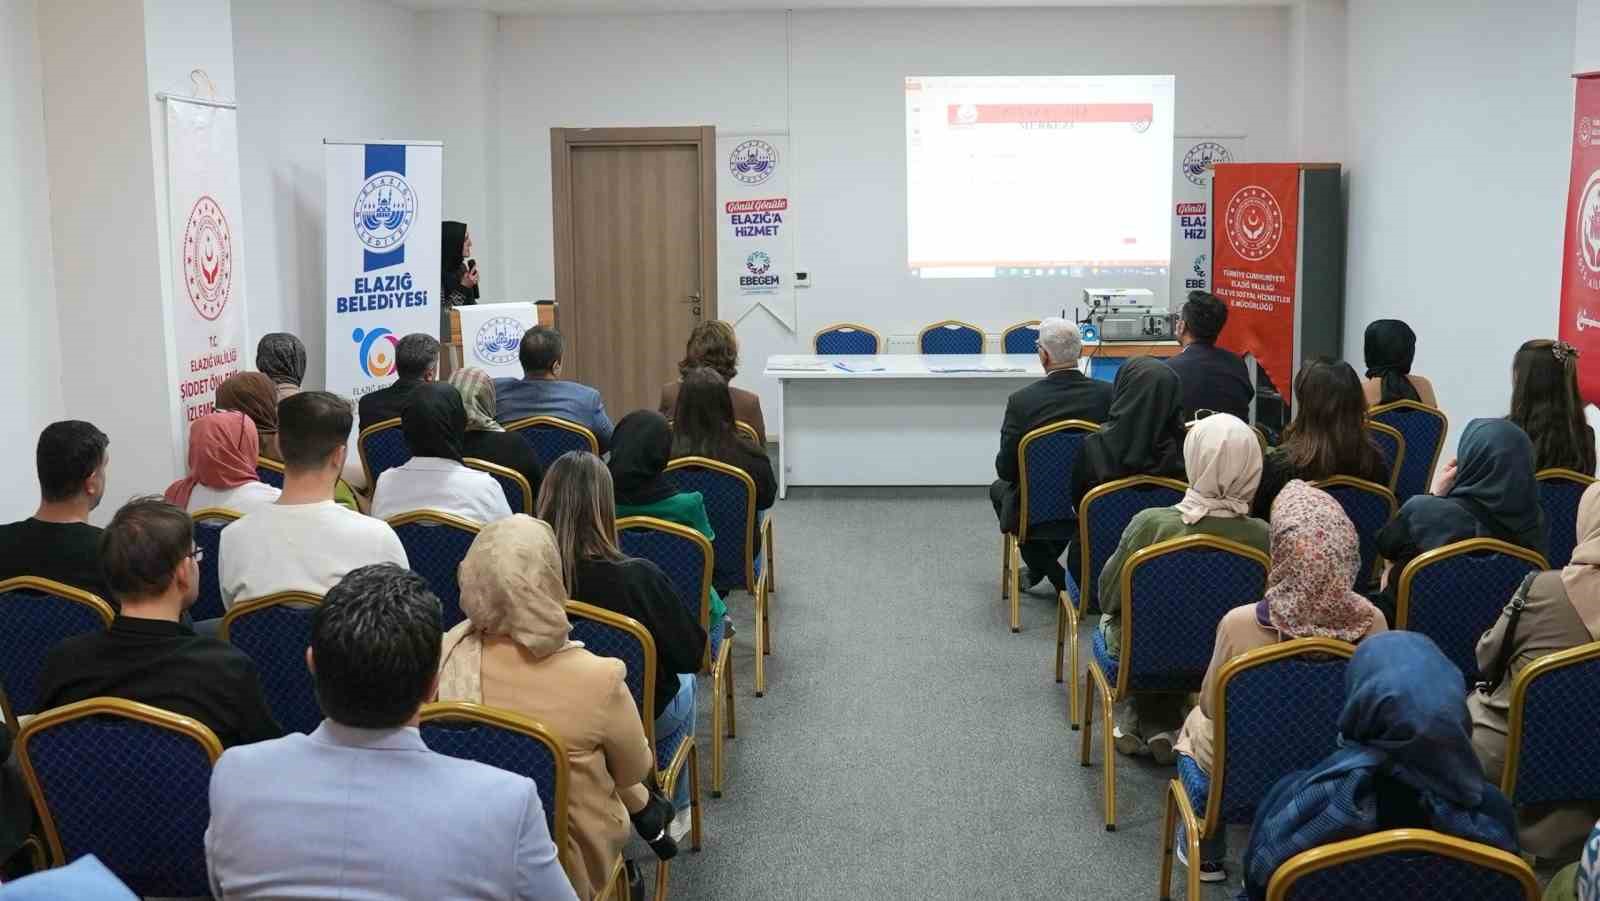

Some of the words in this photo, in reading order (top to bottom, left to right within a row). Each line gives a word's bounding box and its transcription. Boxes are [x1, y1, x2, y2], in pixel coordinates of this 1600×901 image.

[731, 212, 782, 224] ELAZIĞ'A
[355, 272, 412, 294] ELAZIĞ
[740, 275, 779, 286] EBEGEM
[336, 291, 428, 313] BELEDİYESİ
[180, 379, 209, 402] ŞİDDET
